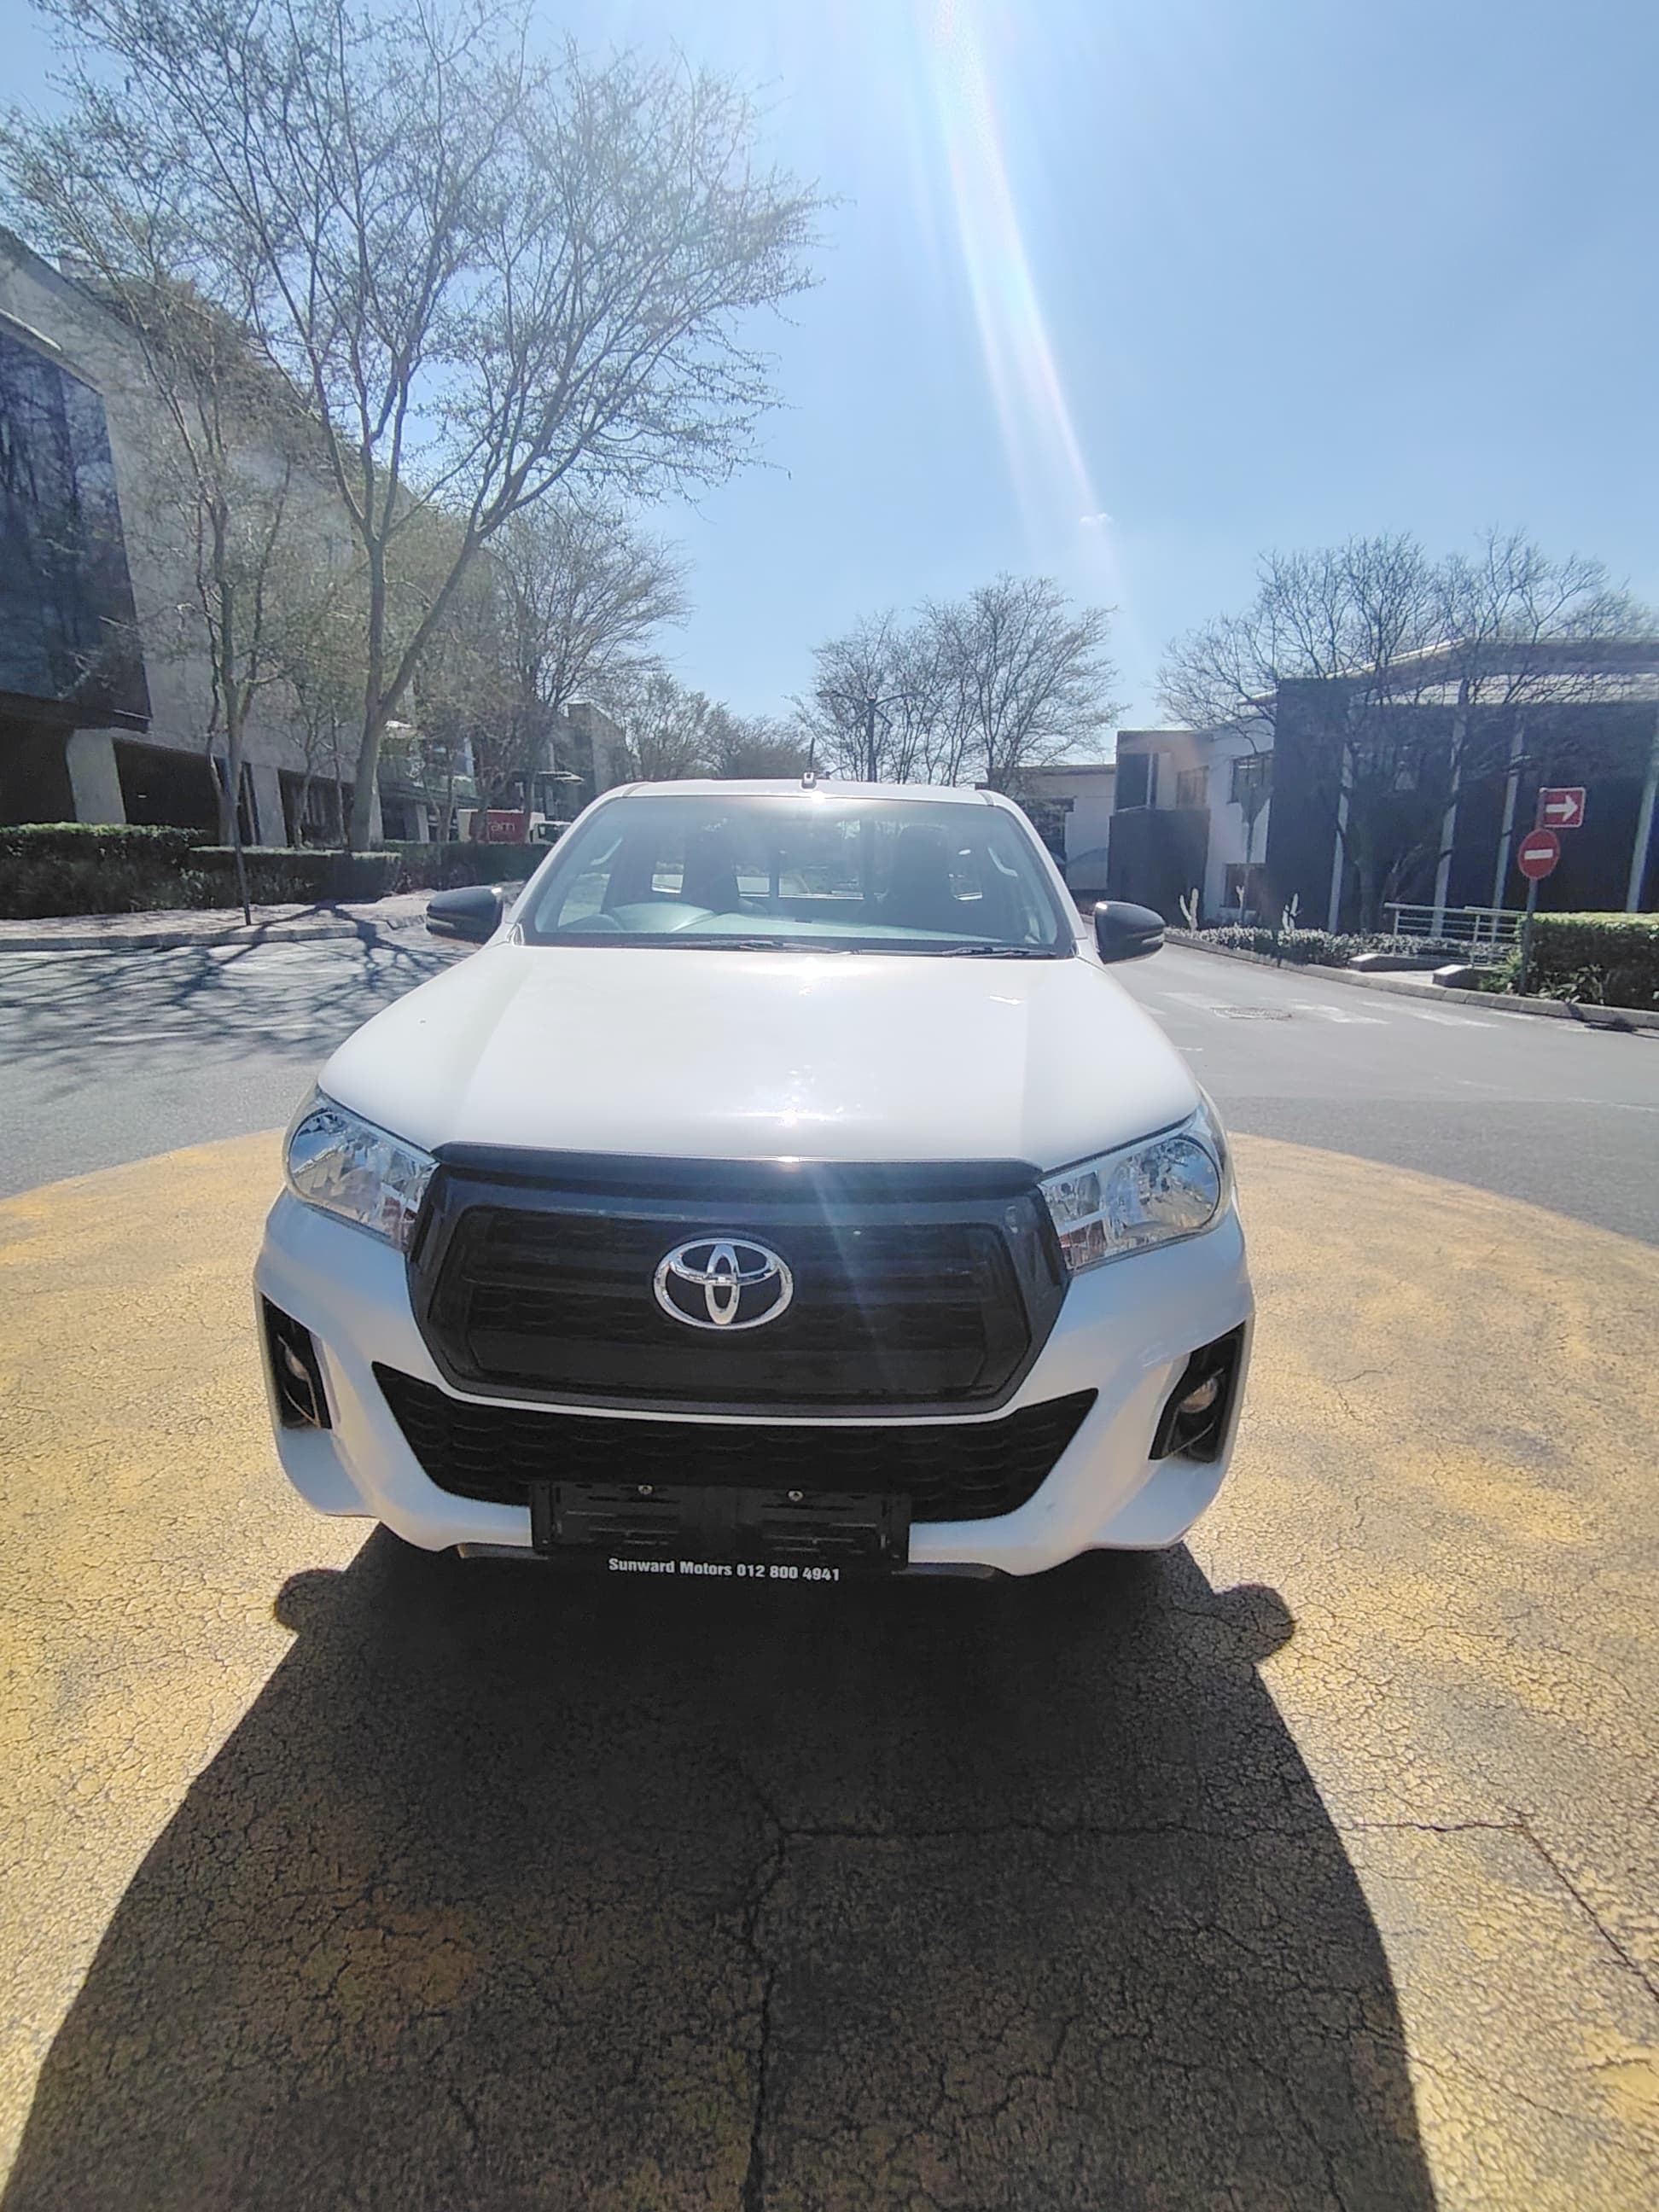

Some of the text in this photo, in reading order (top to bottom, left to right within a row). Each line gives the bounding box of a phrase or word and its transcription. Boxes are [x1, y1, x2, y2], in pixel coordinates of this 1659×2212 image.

[608, 1557, 840, 1581] Sunward Motors 012 800 4941
